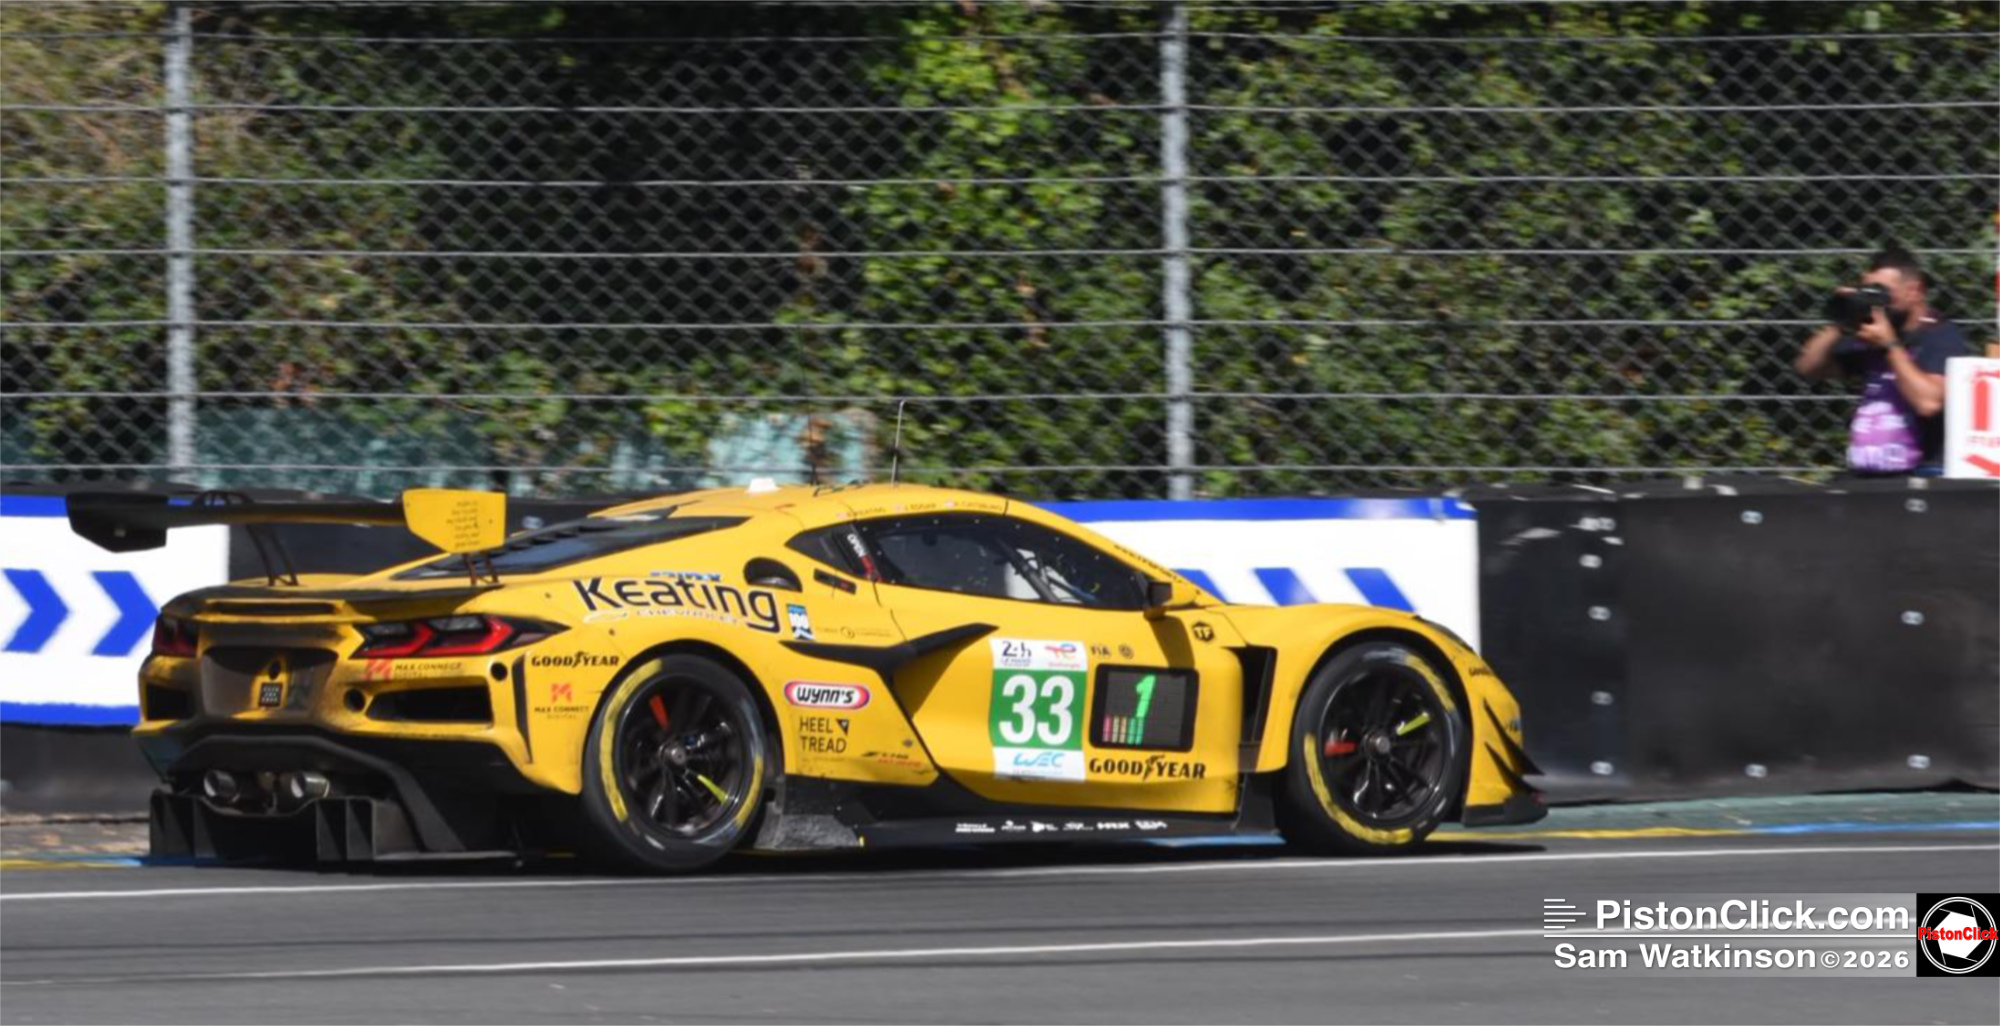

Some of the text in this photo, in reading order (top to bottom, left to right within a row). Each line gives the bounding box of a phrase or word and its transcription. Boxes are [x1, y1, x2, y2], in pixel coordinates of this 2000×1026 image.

[572, 576, 781, 633] Keating
[531, 651, 620, 668] GOODYEAR
[1135, 674, 1156, 717] 1
[998, 674, 1075, 745] 33
[800, 717, 834, 734] HEEL
[800, 736, 847, 753] TREAD
[1089, 755, 1207, 781] GOODYEAR
